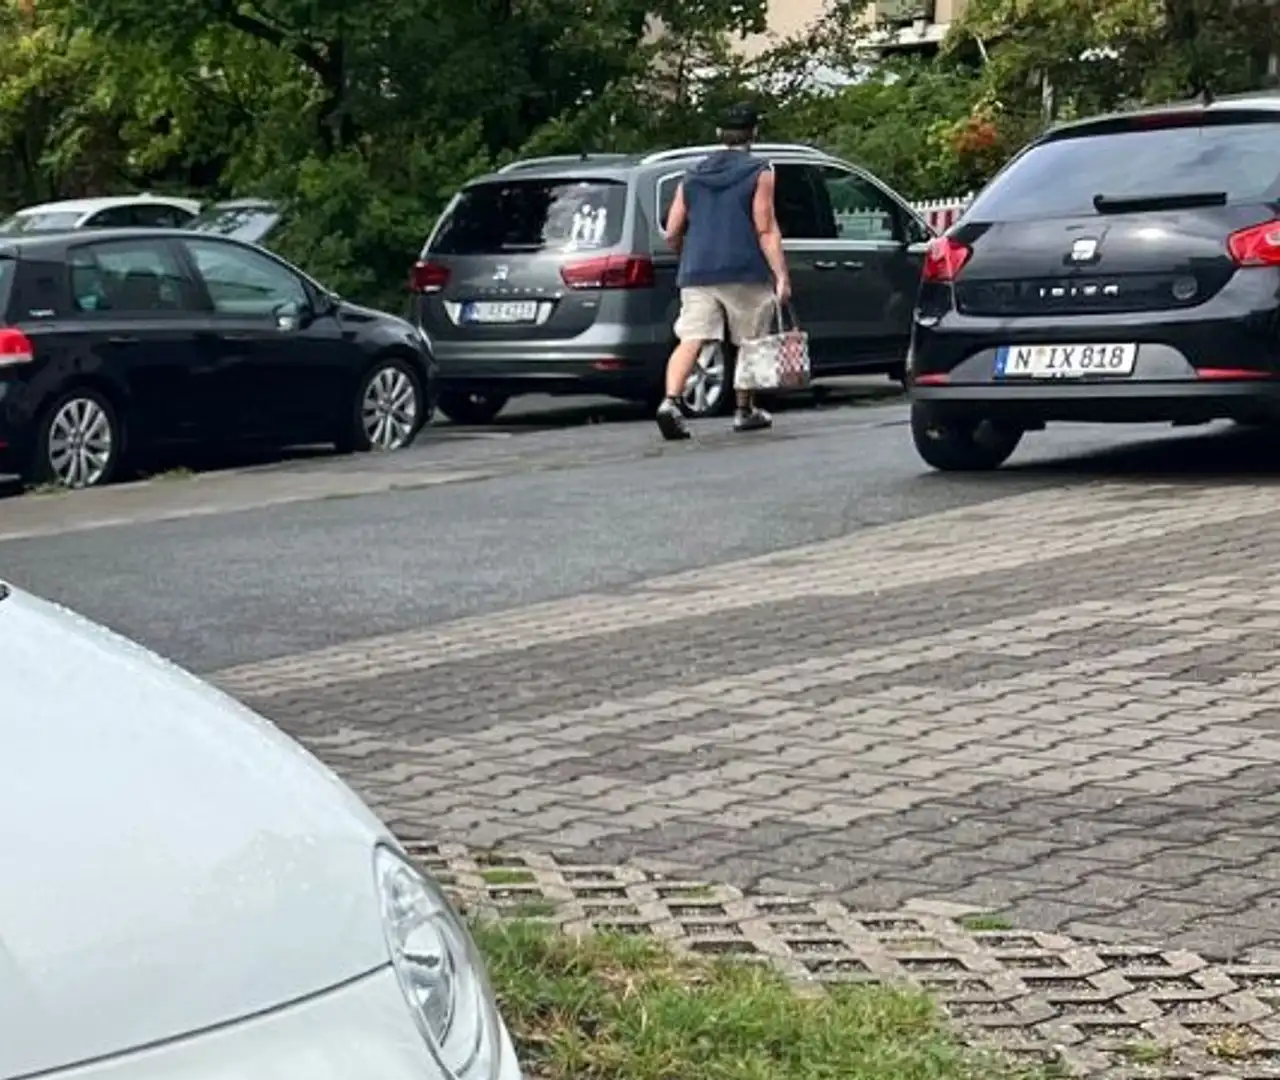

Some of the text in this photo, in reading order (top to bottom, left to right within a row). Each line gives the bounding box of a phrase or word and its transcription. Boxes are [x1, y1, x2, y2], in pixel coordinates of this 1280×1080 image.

[1014, 345, 1124, 369] N IX 818
